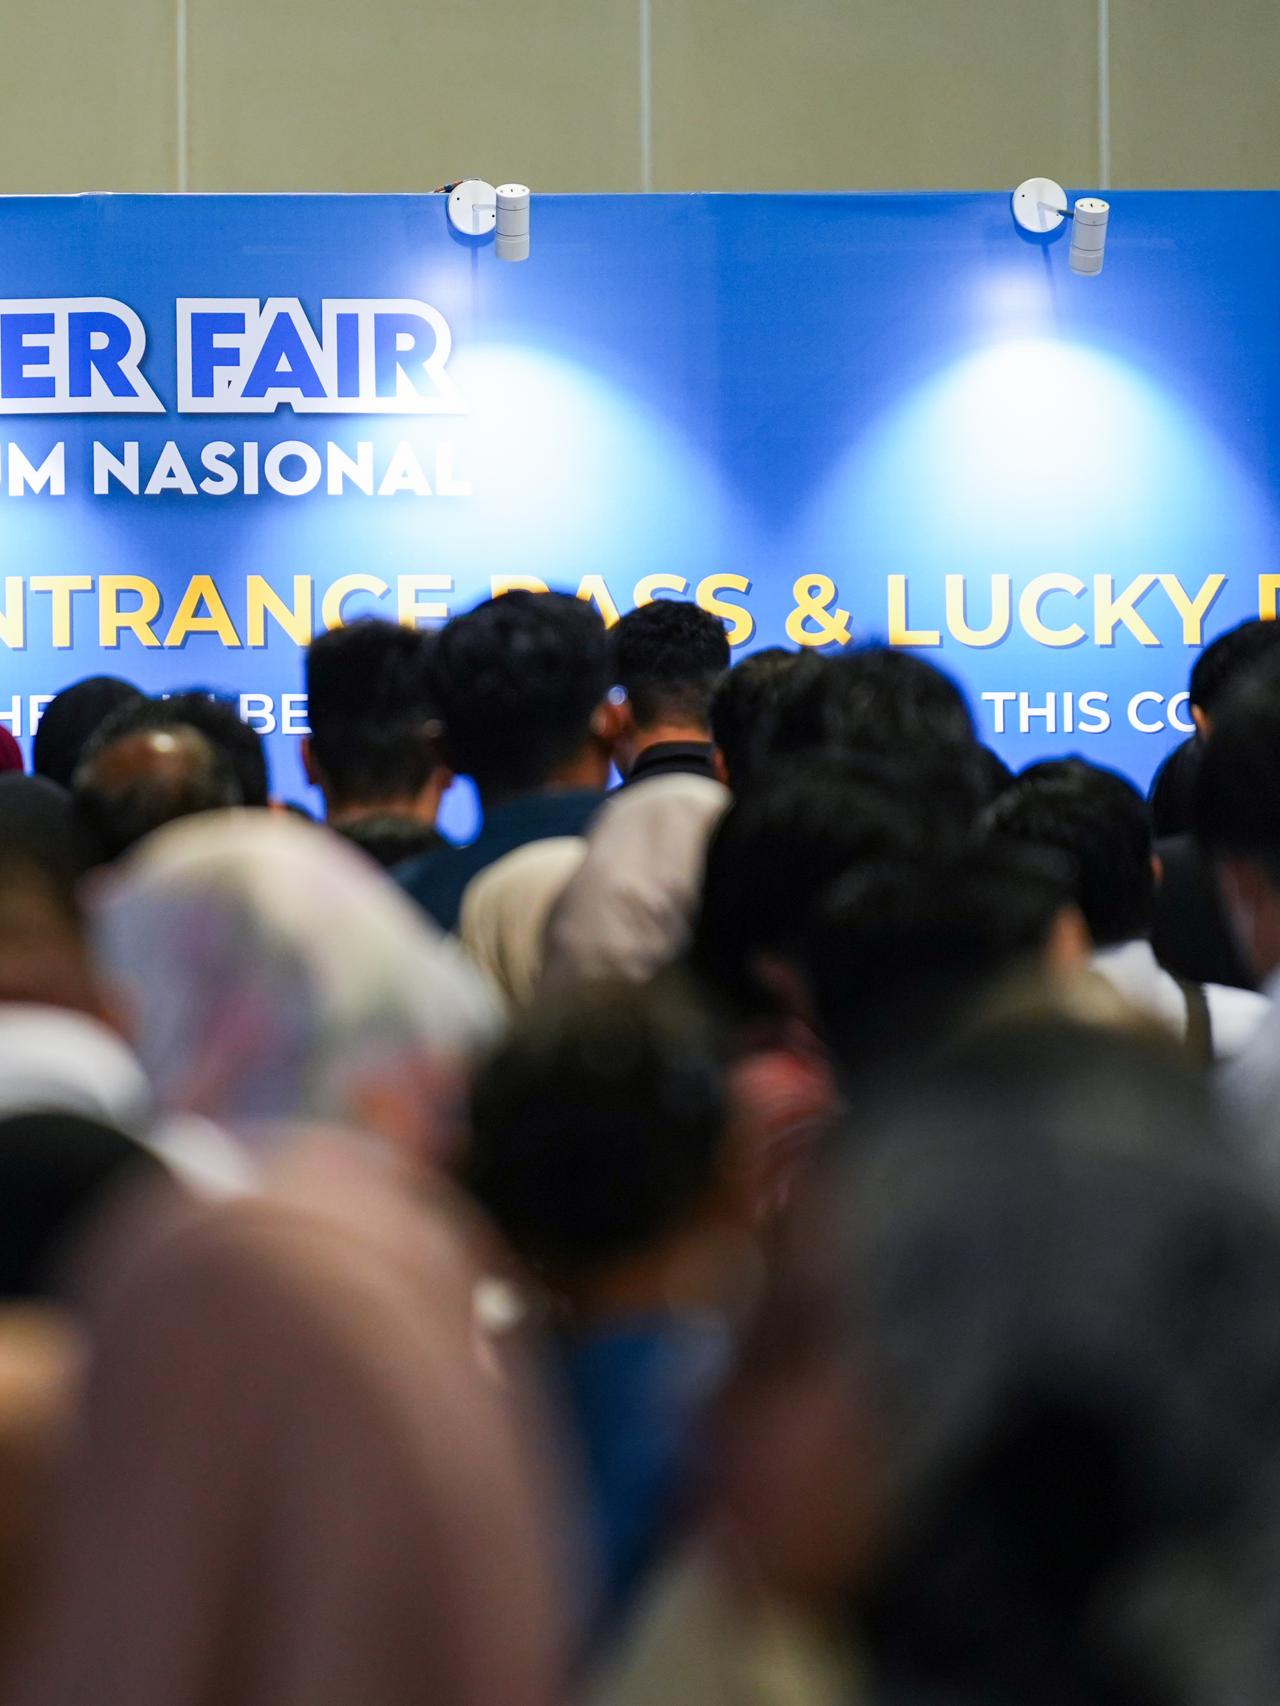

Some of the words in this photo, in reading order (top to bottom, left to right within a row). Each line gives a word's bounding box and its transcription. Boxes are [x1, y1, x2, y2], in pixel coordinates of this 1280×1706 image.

[176, 297, 472, 414] FAIR
[94, 440, 472, 496] NASIONAL
[785, 573, 852, 647] &
[888, 573, 1226, 648] LUCKY
[981, 691, 1111, 734] THIS
